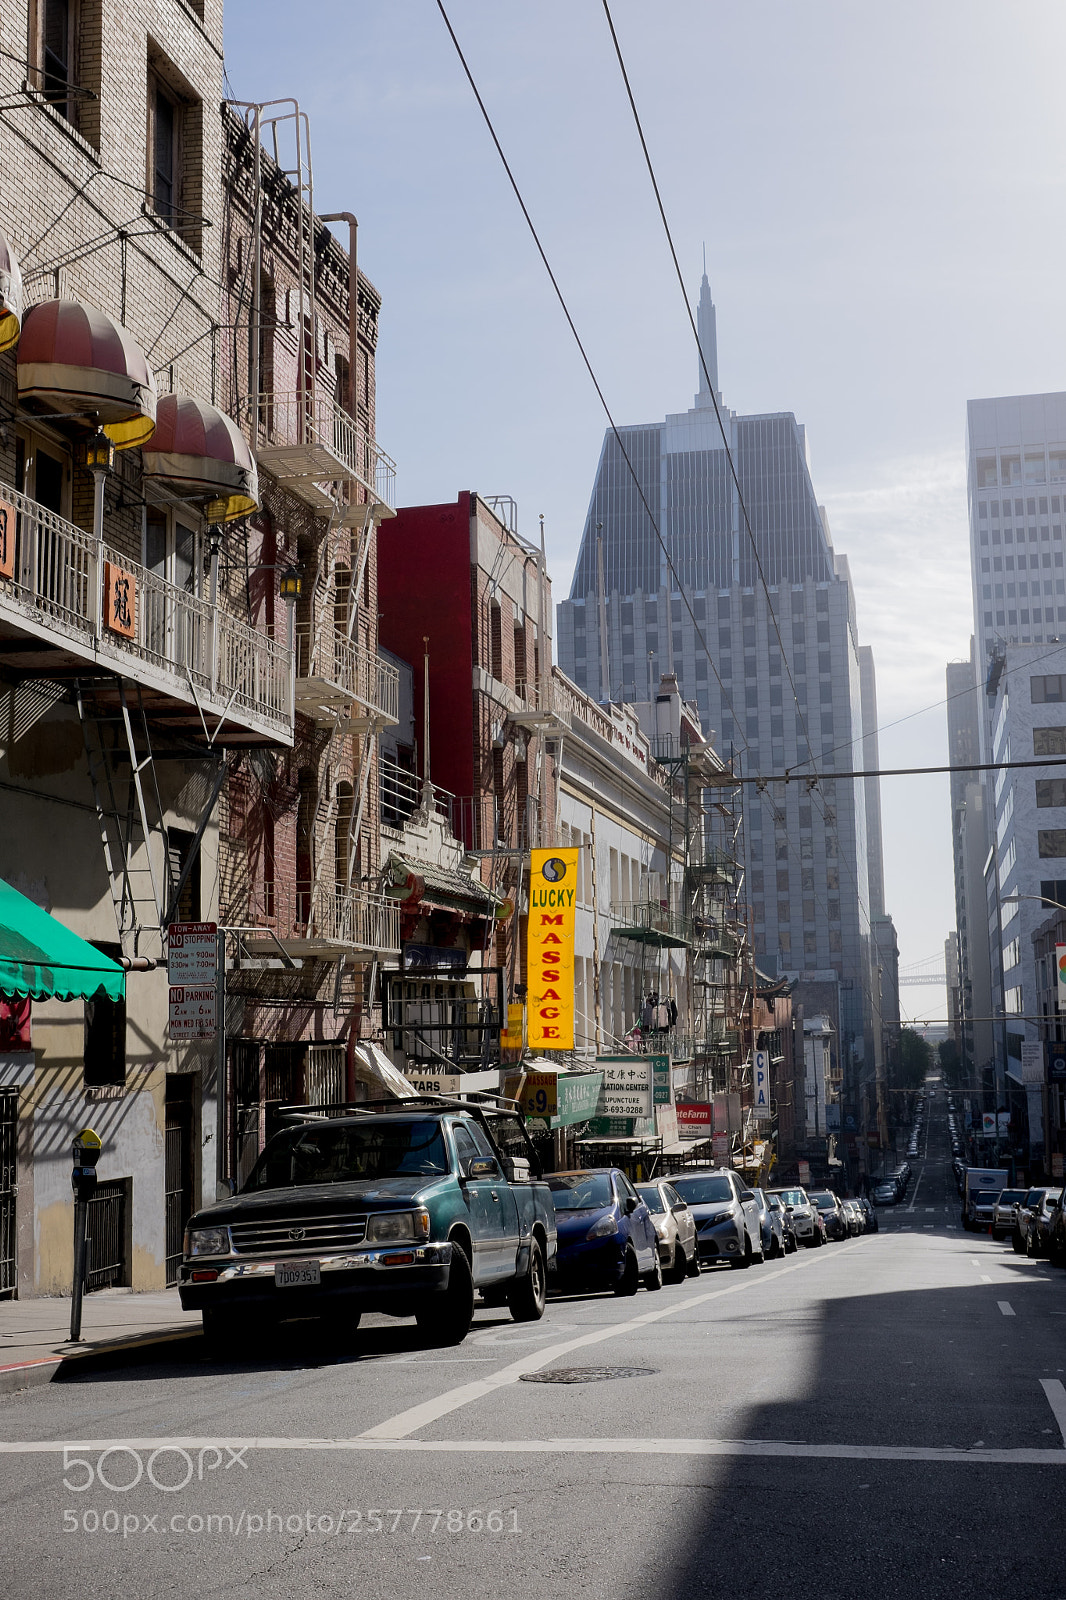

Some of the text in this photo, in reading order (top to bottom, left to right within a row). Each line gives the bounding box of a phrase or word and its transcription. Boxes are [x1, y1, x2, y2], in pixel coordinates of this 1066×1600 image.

[532, 889, 574, 907] LUCKY
[170, 935, 215, 946] NO STOPPING
[540, 914, 564, 1039] MASSAGE
[170, 988, 214, 1002] NO PARKING
[171, 1019, 181, 1028] MON
[184, 1019, 194, 1028] WED
[205, 1018, 215, 1027] SAT
[527, 1075, 557, 1086] MASSAGE
[756, 1053, 766, 1105] CPA
[409, 1080, 440, 1092] TARS
[625, 1083, 649, 1091] CENTER
[548, 1103, 557, 1113] UP
